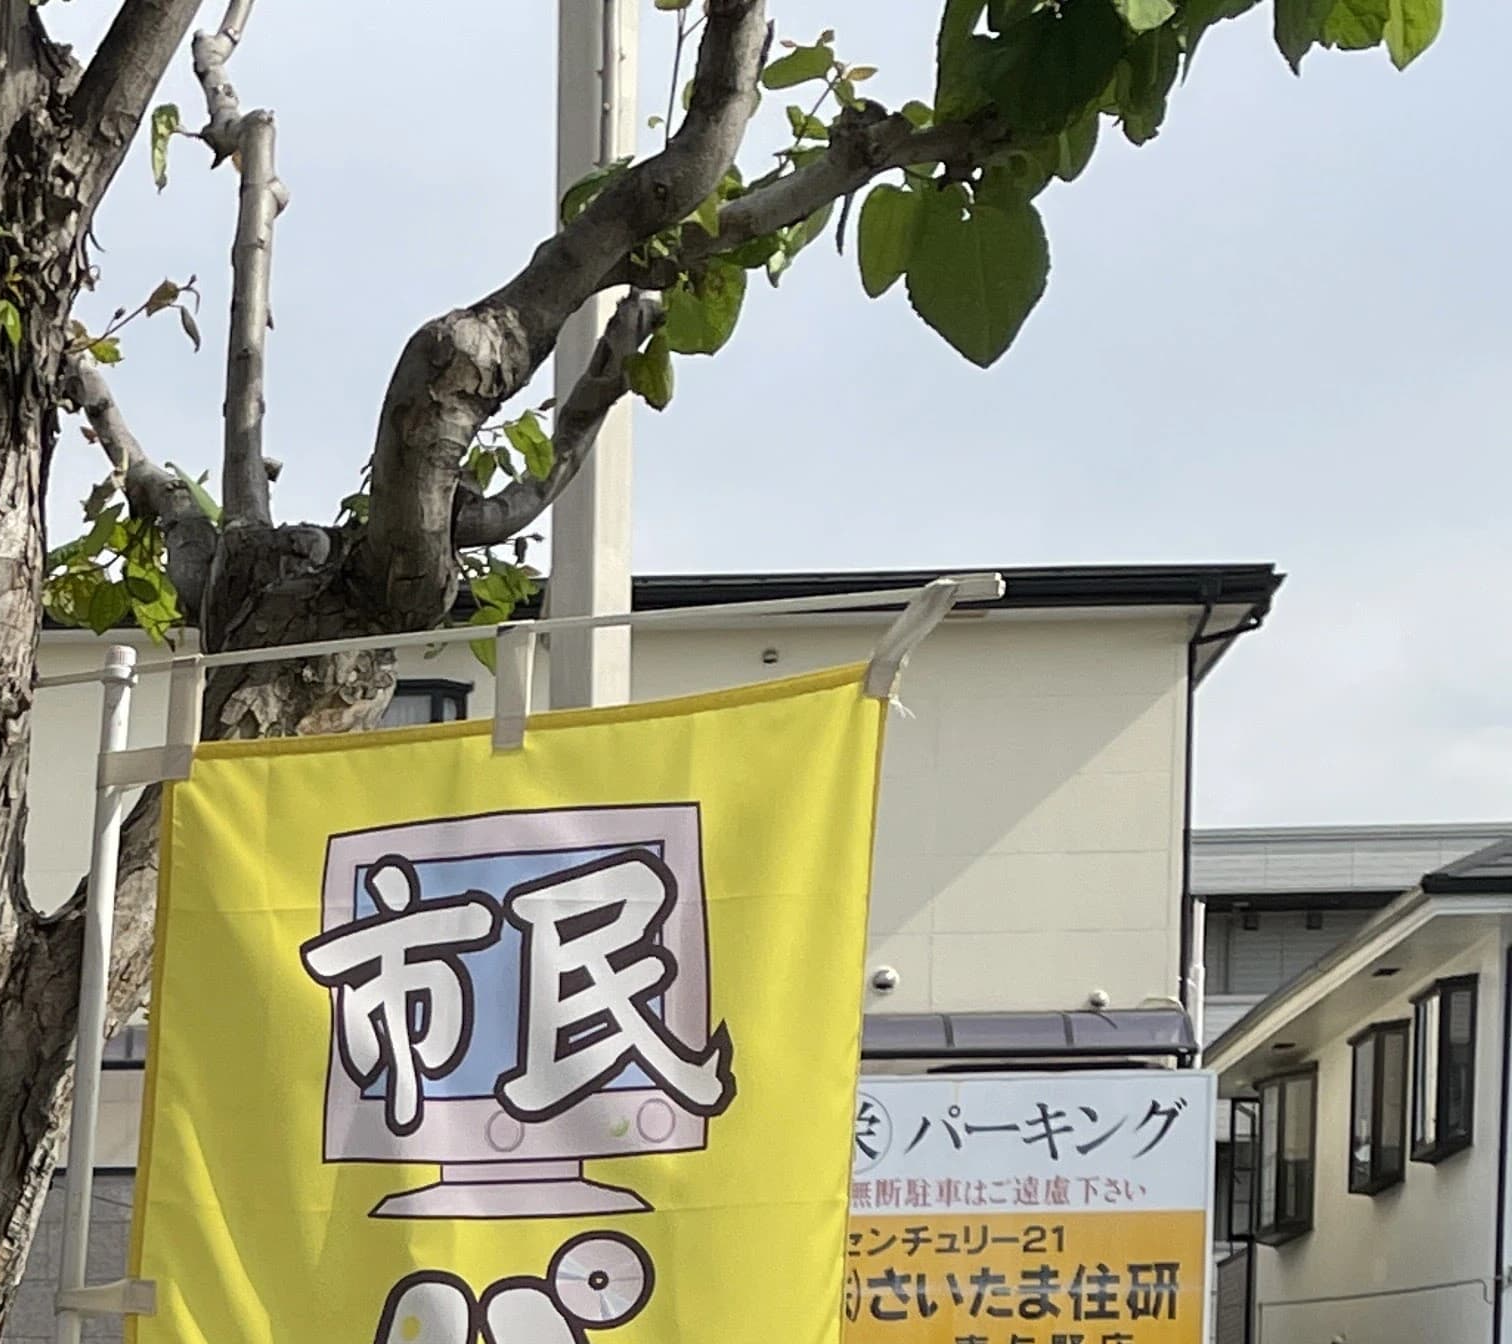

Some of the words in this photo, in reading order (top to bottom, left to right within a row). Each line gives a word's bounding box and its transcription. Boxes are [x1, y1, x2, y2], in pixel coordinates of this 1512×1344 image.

[300, 850, 736, 1136] 市民
[903, 1096, 1188, 1161] パーキング
